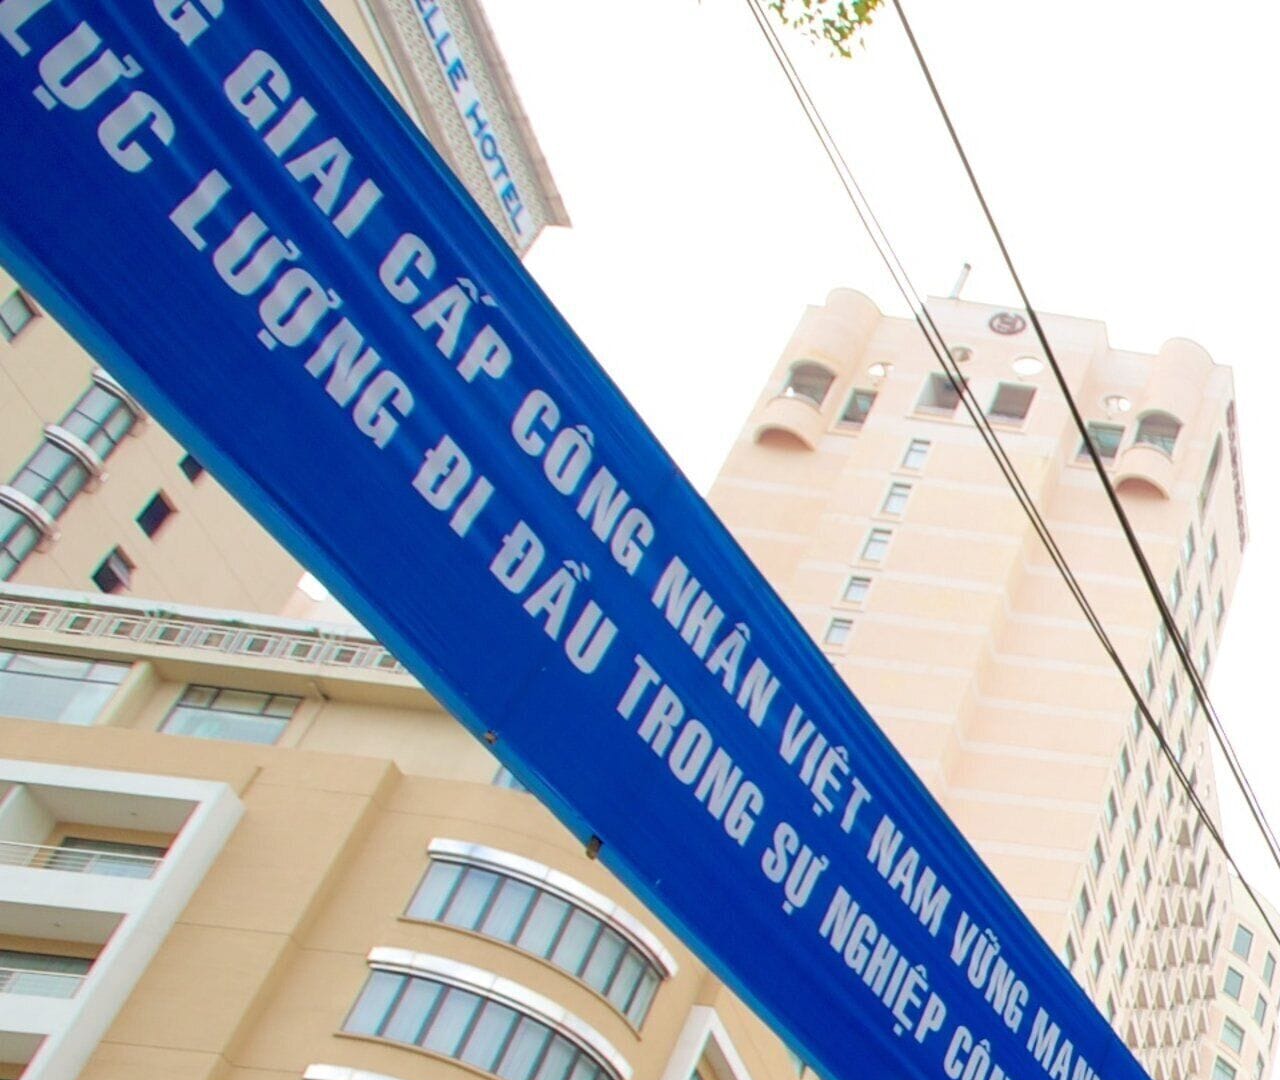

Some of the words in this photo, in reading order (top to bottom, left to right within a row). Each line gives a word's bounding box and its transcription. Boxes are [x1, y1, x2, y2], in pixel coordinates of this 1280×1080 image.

[0, 0, 175, 173] LỰC
[168, 168, 415, 449] LƯỢNG
[411, 434, 495, 538] ĐI
[489, 519, 619, 674] ĐẦU
[616, 654, 764, 847] TRONG
[761, 822, 830, 916] SỰ
[819, 885, 947, 1044] NGHIỆP
[223, 49, 384, 239] GIAI
[379, 232, 512, 384] CẤP
[511, 389, 655, 576] CÔNG
[651, 555, 781, 728] NHÂN
[779, 703, 871, 834] VIỆT
[866, 814, 951, 938] NAM
[950, 911, 1029, 1034] VỮNG
[464, 101, 524, 236] HOTEL
